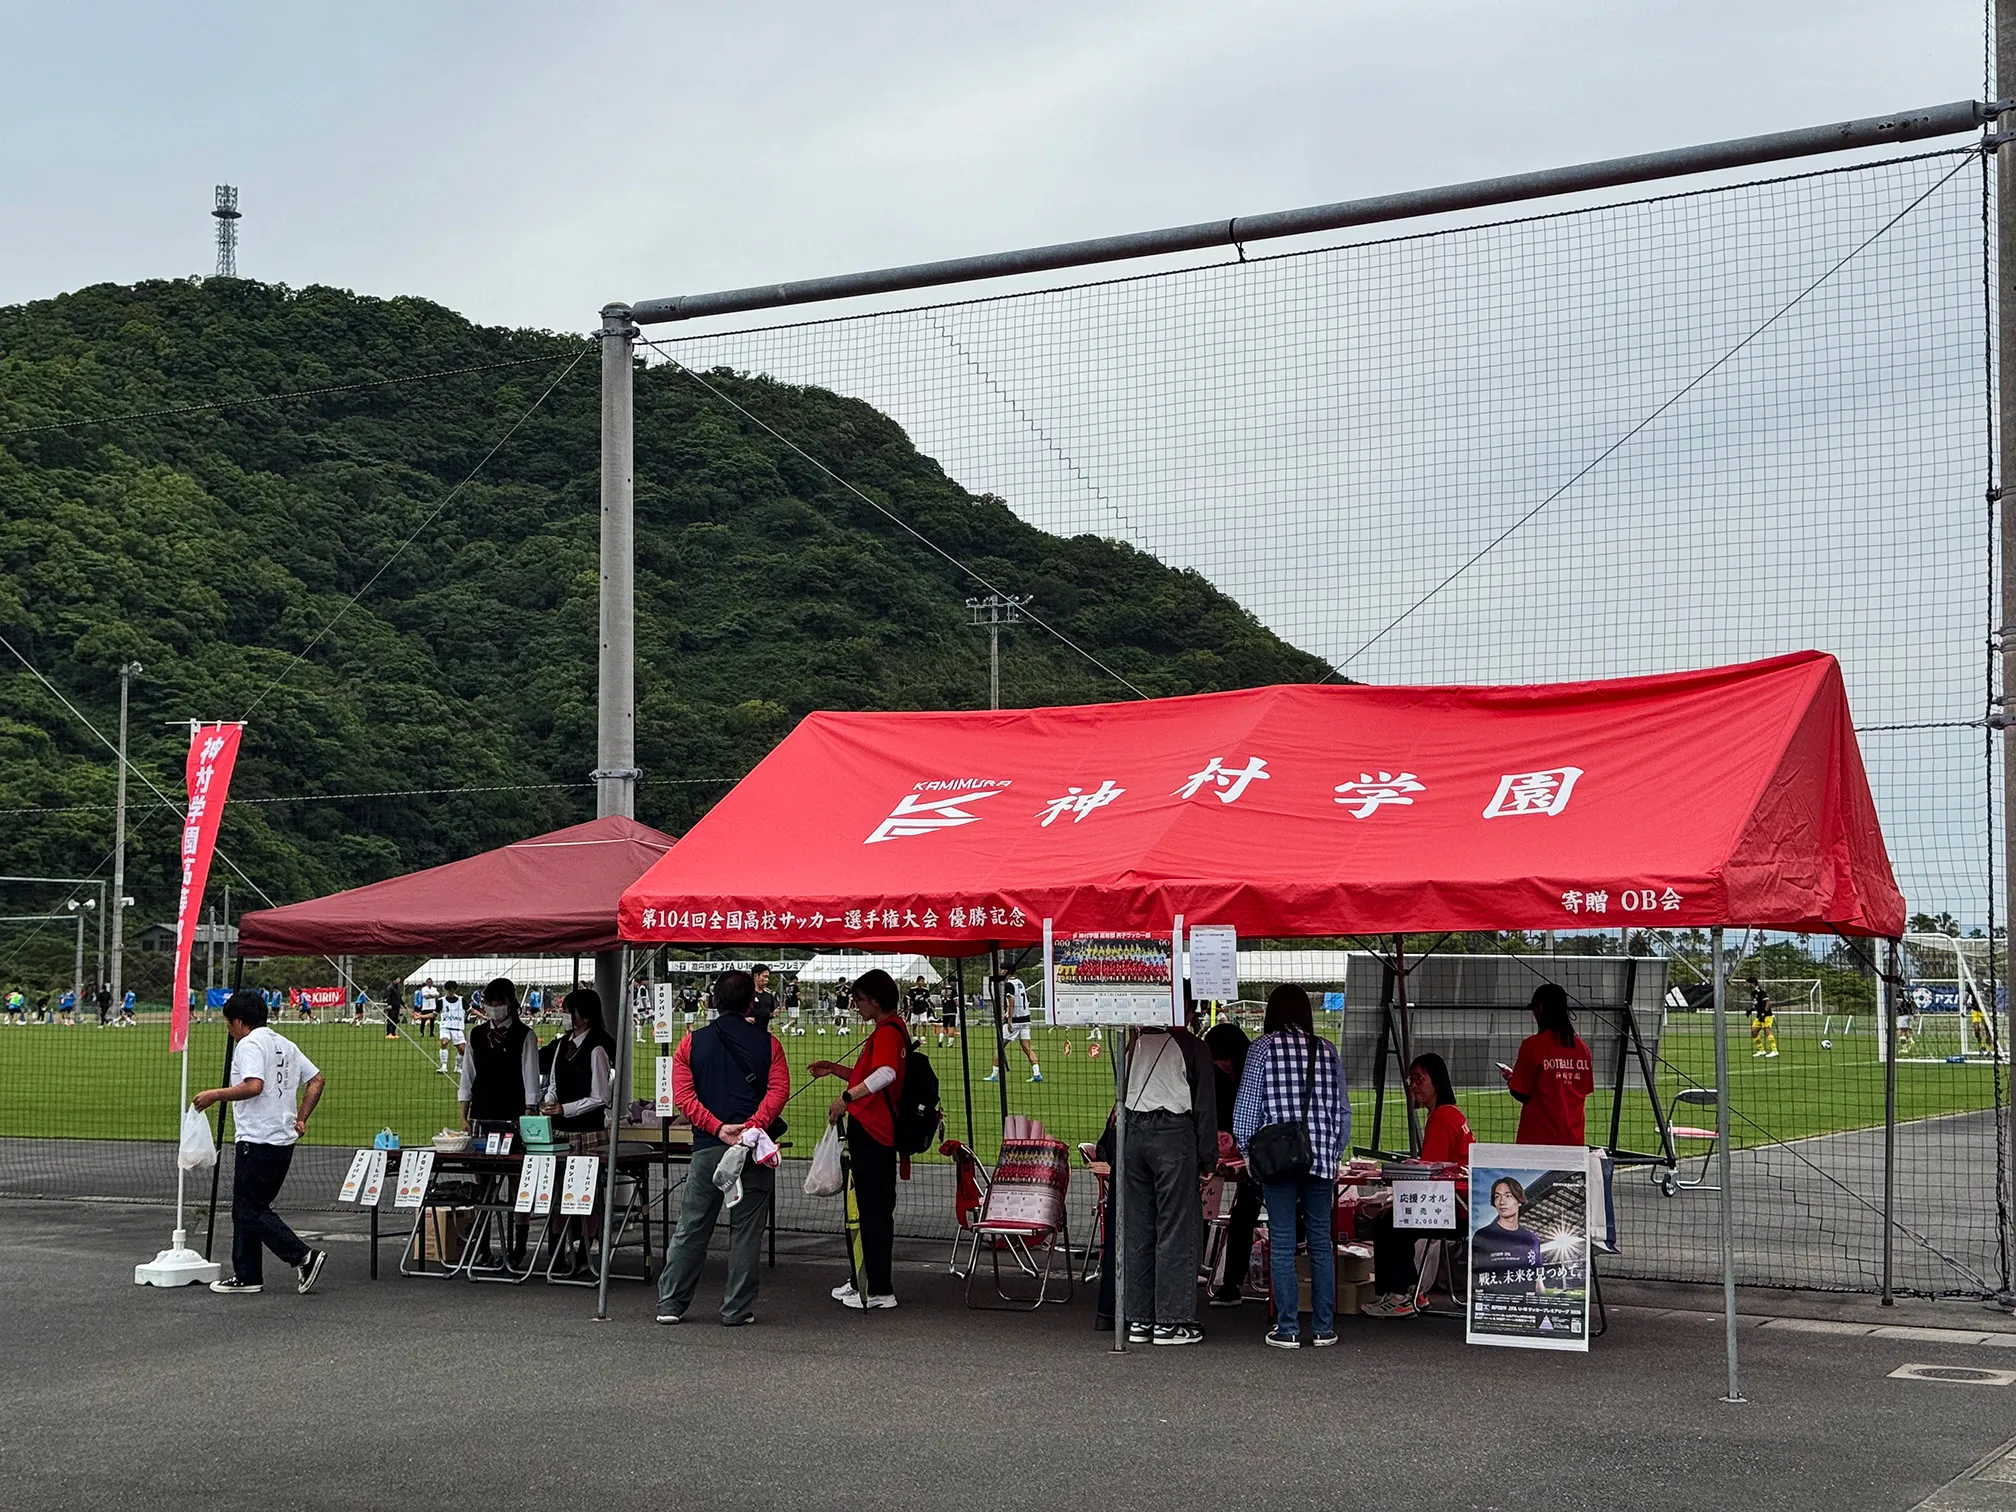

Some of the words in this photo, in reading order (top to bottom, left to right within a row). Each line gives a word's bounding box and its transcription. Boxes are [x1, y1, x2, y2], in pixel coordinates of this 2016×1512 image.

[912, 778, 1012, 792] KAMIMURA
[1033, 756, 1584, 829] 神村学園
[1561, 889, 1609, 914] 寄贈
[1621, 887, 1684, 911] OB会
[642, 908, 940, 931] 第104回全国高校サッカー選手権大会
[949, 905, 1027, 928] 優勝記念
[312, 991, 340, 1003] KIRIN
[523, 1157, 534, 1188] メロンパン
[566, 1158, 576, 1190] メロンパン
[1400, 1193, 1448, 1204] 応援タオル
[1479, 1264, 1582, 1286] 戦え、未来を見つめて。
